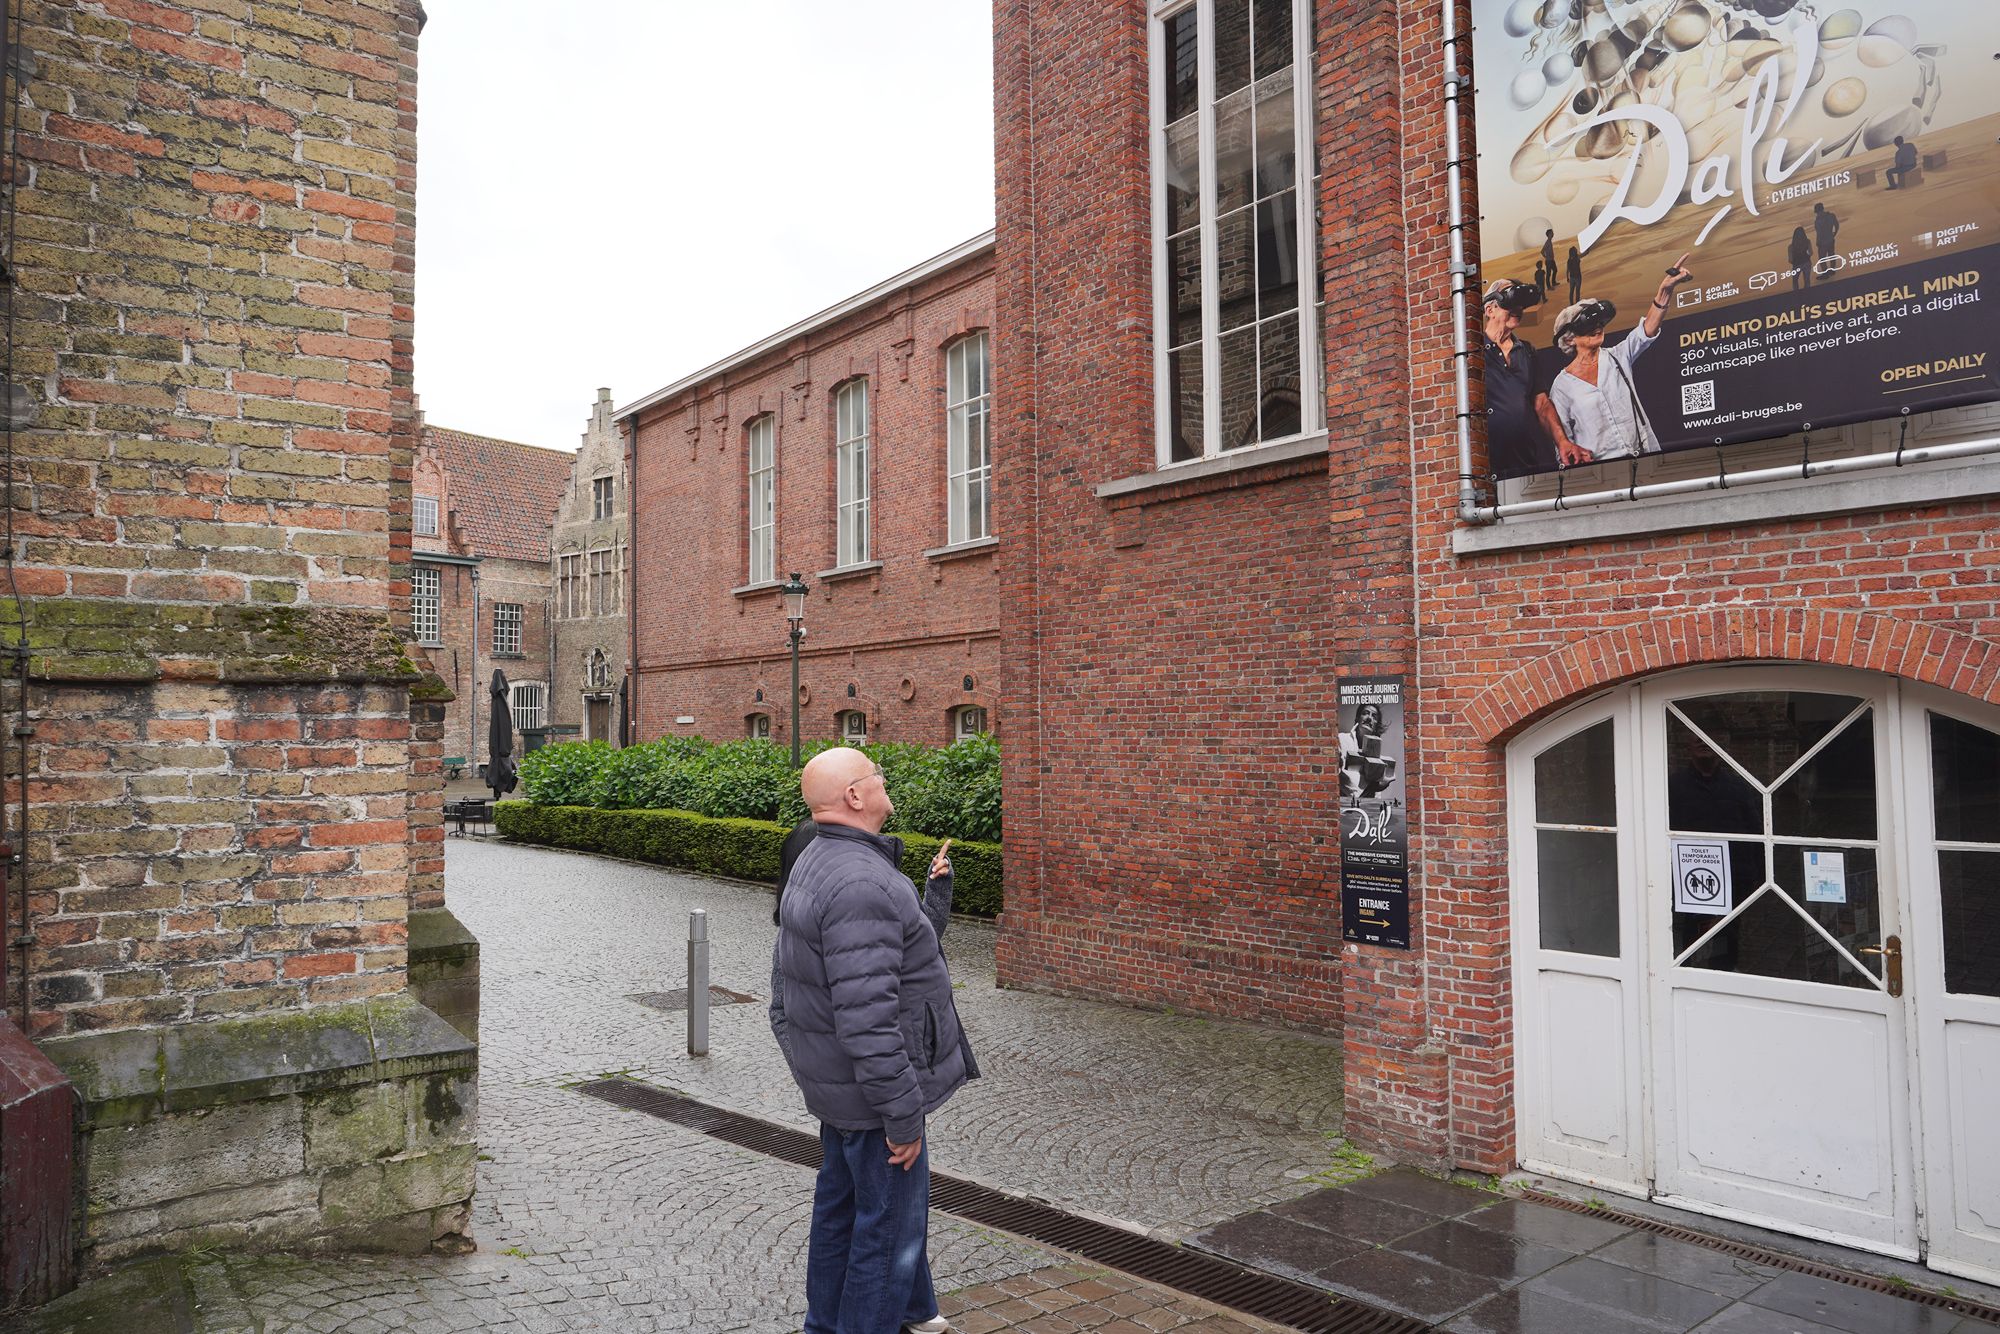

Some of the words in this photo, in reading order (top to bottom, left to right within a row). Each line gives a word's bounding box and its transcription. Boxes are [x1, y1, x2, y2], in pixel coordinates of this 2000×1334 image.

[1543, 20, 1823, 253] Dalí
[1936, 222, 1979, 239] DIGITAL
[1936, 235, 1958, 247] ART
[1848, 251, 1862, 260] VR
[1864, 242, 1898, 255] WALK-
[1848, 250, 1899, 267] THROUGH
[1706, 285, 1720, 295] 400
[1706, 288, 1740, 301] SCREEN
[1679, 327, 1717, 348] DIVE
[1721, 318, 1762, 339] INTO
[1825, 285, 1916, 316] SURREAL
[1923, 270, 1980, 295] MIND
[1711, 337, 1762, 356] visuals,
[1766, 319, 1844, 345] interactive
[1847, 312, 1873, 328] art,
[1876, 304, 1907, 322] and
[1912, 304, 1922, 314] a
[1926, 288, 1981, 311] digital
[1680, 351, 1766, 377] dreamscape
[1770, 344, 1795, 360] like
[1799, 336, 1842, 354] never
[1845, 325, 1901, 345] before.
[1880, 362, 1930, 382] OPEN
[1934, 352, 1987, 374] DAILY
[1683, 402, 1803, 430] www.dali-bruges.be
[1340, 685, 1373, 694] IMMERSIVE
[1374, 684, 1400, 694] JOURNEY
[1341, 696, 1355, 704] INTO
[1356, 696, 1360, 704] A
[1361, 695, 1382, 704] GENIUS
[1383, 695, 1399, 704] MIND
[1359, 898, 1390, 910] ENTRANCE
